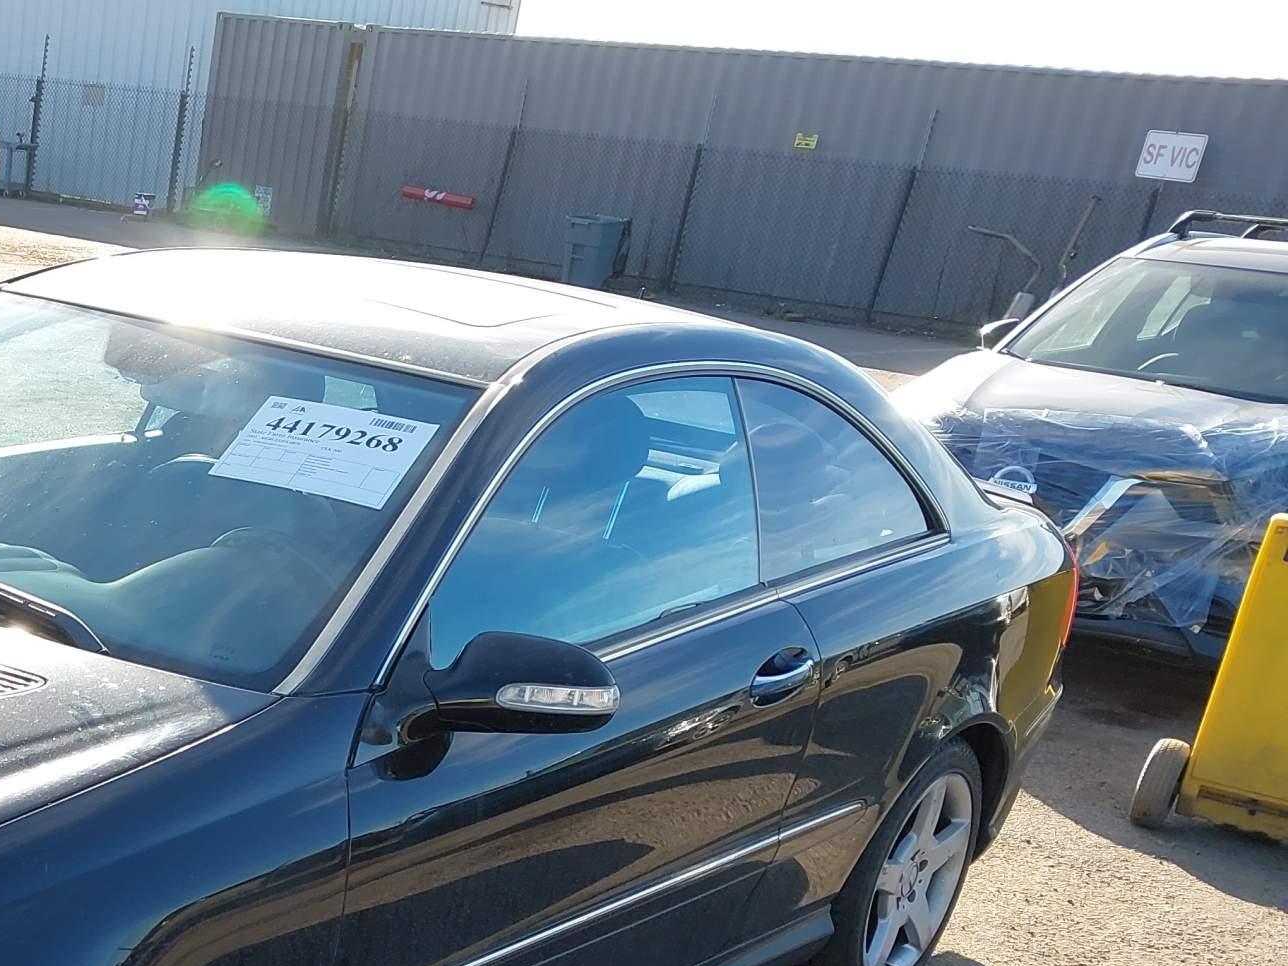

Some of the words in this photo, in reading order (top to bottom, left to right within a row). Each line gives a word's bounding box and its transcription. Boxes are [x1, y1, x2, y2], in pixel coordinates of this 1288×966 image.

[1143, 143, 1167, 165] SF
[1170, 145, 1199, 168] VIC
[266, 416, 403, 452] 44179268
